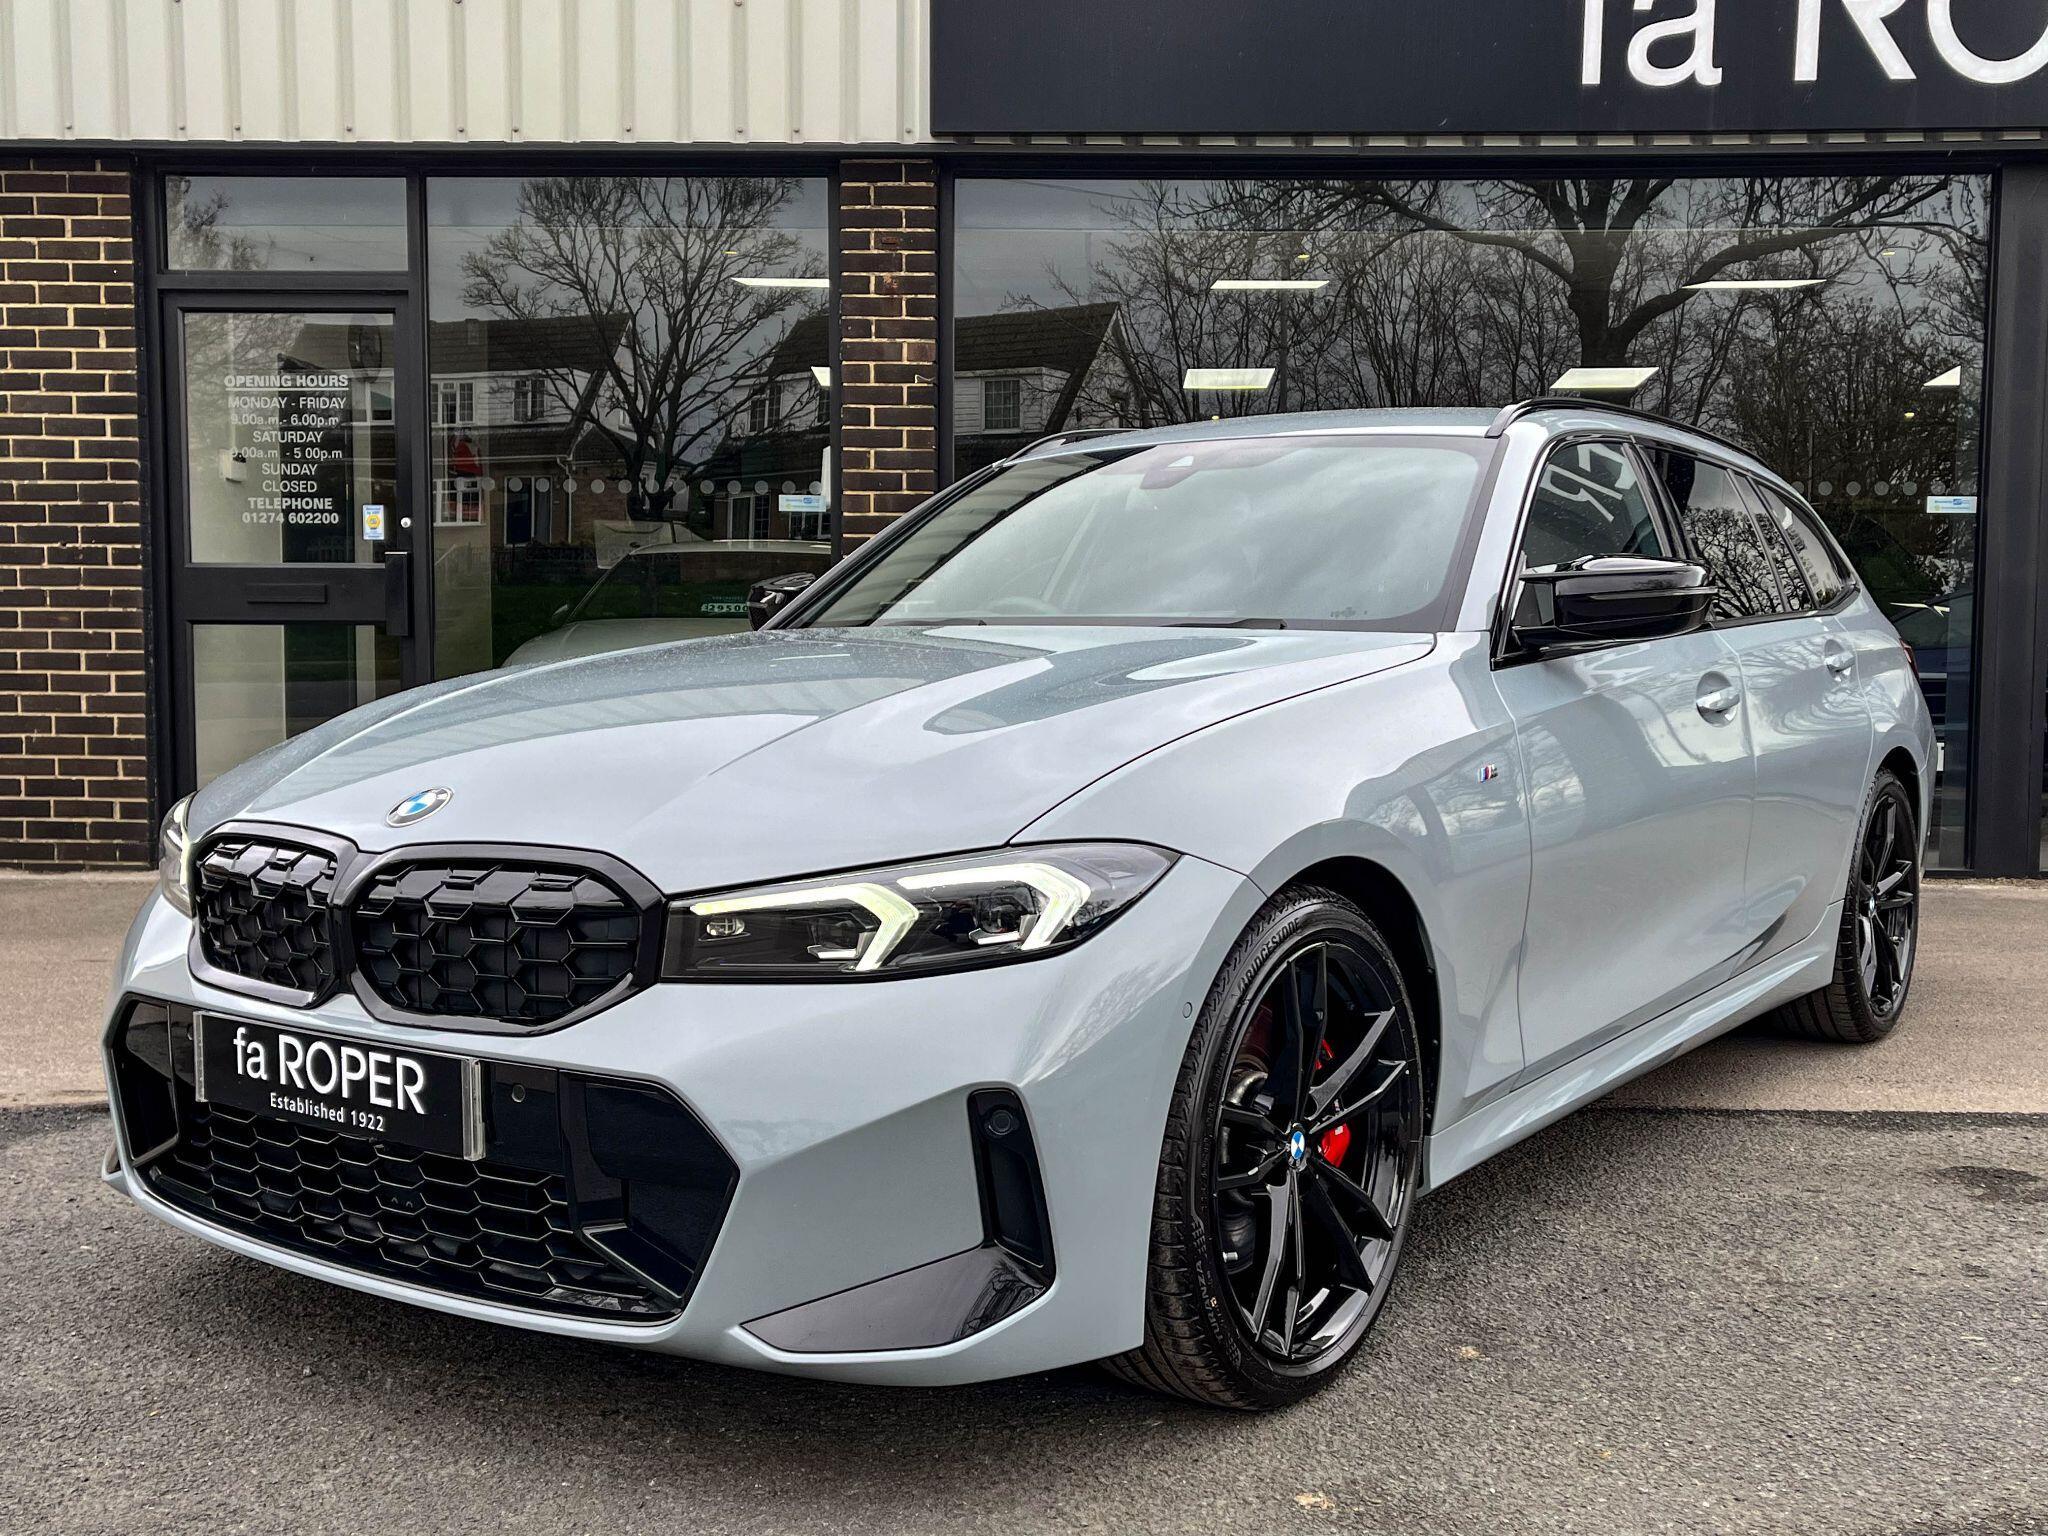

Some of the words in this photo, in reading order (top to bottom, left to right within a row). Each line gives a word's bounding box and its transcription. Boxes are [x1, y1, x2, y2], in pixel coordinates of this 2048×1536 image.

[223, 374, 291, 387] OPENING
[296, 374, 349, 387] HOURS
[228, 396, 288, 409] MONDAY
[299, 396, 346, 409] FRIDAY
[252, 430, 324, 443] SATURDAY
[261, 462, 318, 476] SUNDAY
[262, 480, 318, 493] CLOSED
[247, 497, 333, 510] TELEPHONE
[241, 511, 285, 524] 01274
[288, 511, 340, 524] 602200
[233, 1026, 268, 1081] fa
[278, 1034, 425, 1115] ROPER
[270, 1092, 345, 1124] Established
[350, 1110, 385, 1132] 1922
